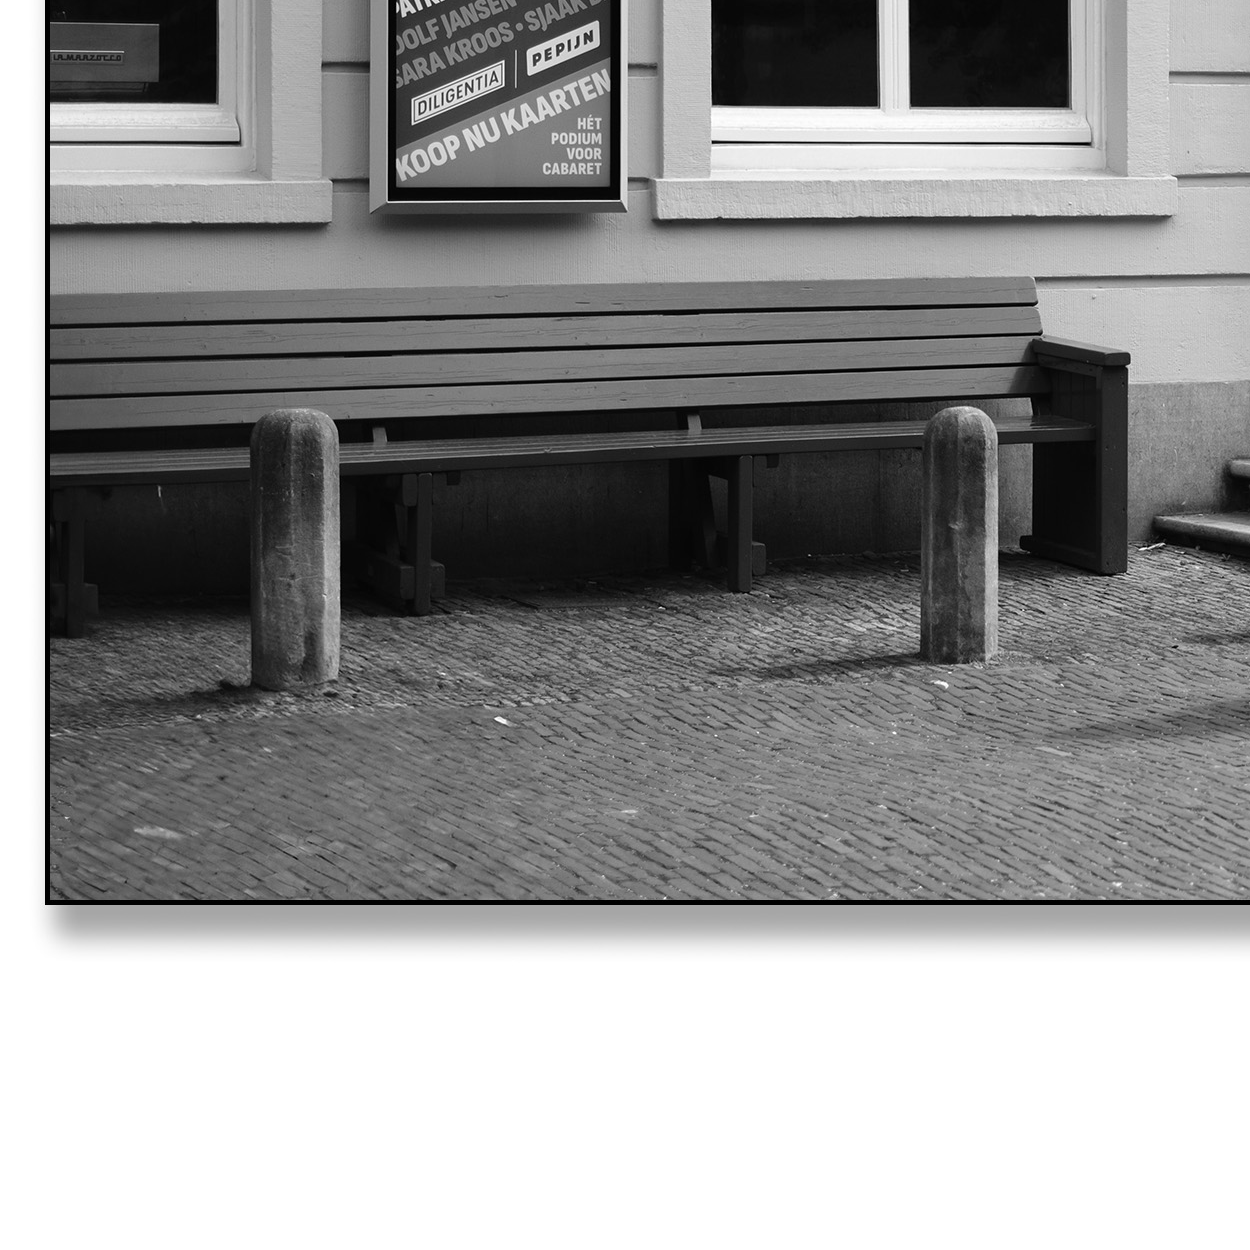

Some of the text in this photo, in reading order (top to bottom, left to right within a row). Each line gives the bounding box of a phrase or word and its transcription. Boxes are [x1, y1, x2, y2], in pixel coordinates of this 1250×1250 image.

[443, 22, 515, 66] KROOS
[532, 29, 594, 67] PEPIJN
[418, 70, 499, 116] DILIGENTIA
[396, 68, 611, 182] KOOP NU KAARTEN
[577, 114, 602, 130] HÉT
[551, 132, 602, 145] PODIUM
[566, 147, 602, 160] VOOR
[542, 162, 602, 175] CABARET
